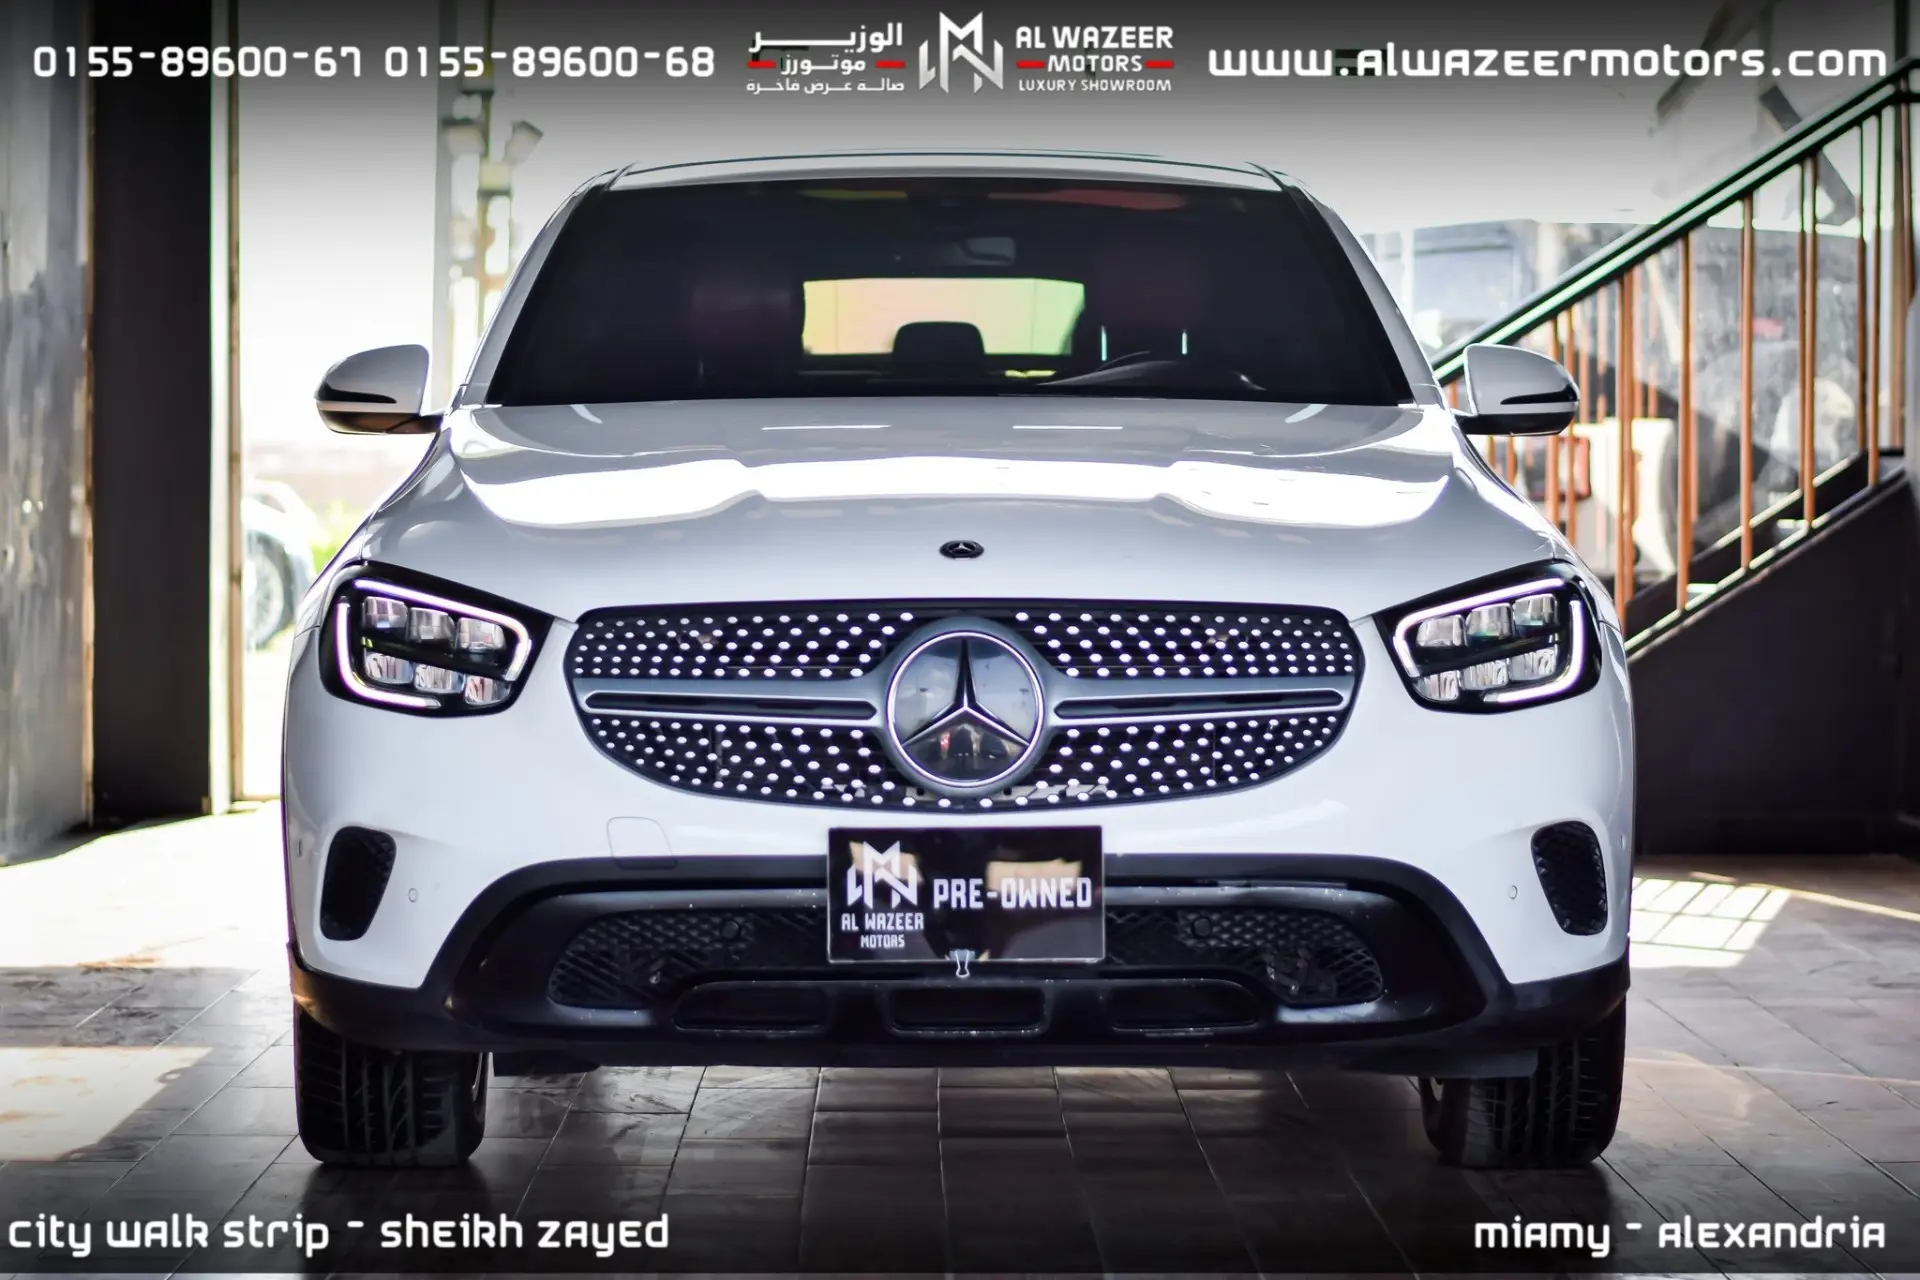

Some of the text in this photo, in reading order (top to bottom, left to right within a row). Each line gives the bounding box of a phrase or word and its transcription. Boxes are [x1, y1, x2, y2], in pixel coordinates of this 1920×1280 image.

[933, 877, 1092, 909] PRE-OWNED
[841, 912, 925, 932] AL WAZEER
[860, 934, 906, 949] MOTORS
